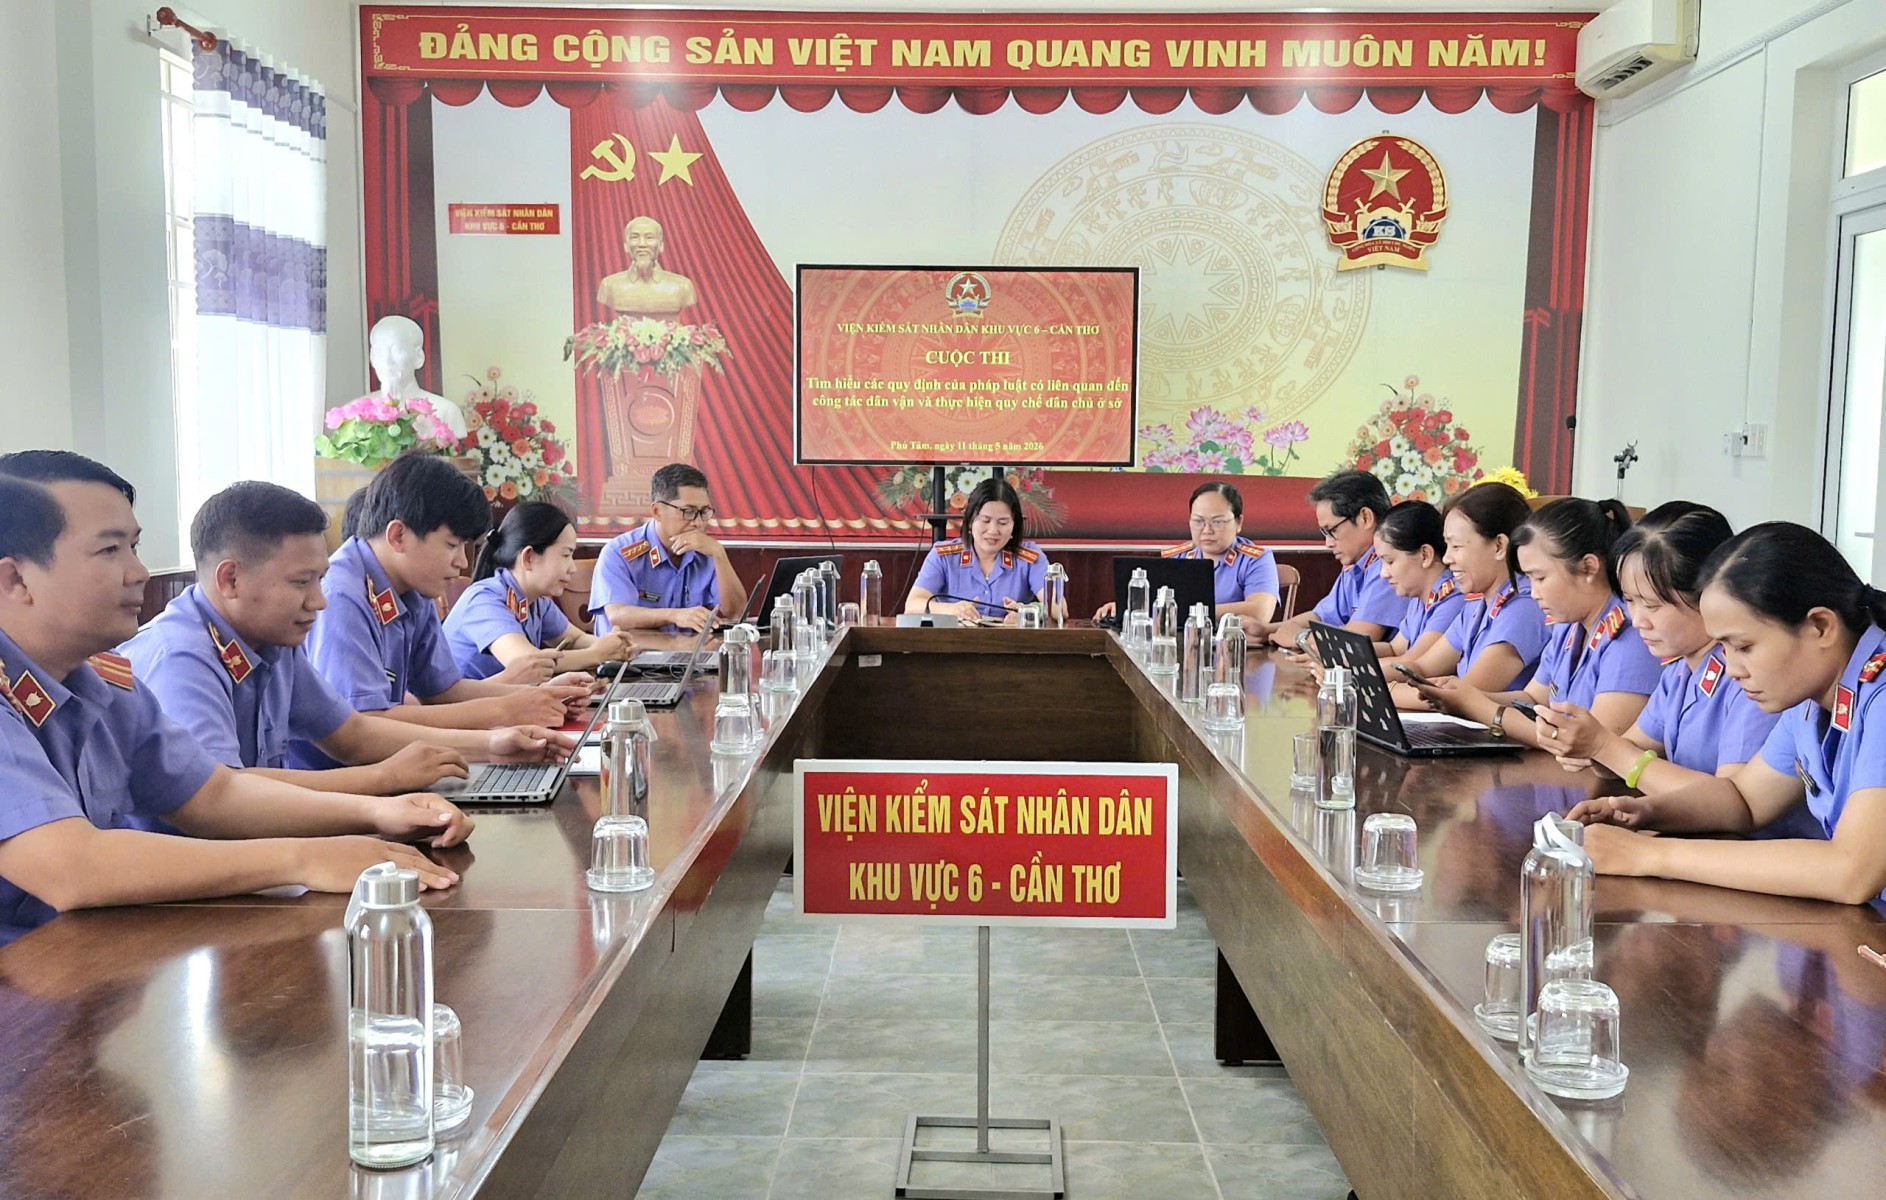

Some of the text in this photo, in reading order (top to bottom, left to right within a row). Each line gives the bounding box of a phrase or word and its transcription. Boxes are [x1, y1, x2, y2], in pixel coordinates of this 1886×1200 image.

[420, 23, 1546, 72] ĐẢNG CỘNG SẢN VIỆT NAM QUANG VINH MUÔN NĂM!
[838, 323, 863, 335] VIỆN
[867, 322, 896, 333] KIỂM
[899, 322, 919, 333] SÁT
[922, 322, 953, 334] NHÂN
[956, 323, 978, 334] DÂN
[981, 325, 1006, 334] KHU
[1008, 325, 1032, 336] VỰC
[1034, 325, 1040, 334] 6
[1050, 324, 1073, 335] CẦN
[1075, 325, 1100, 335] THƠ
[926, 350, 1011, 367] CUỘC THI
[806, 375, 1129, 393] Tìm hiểu các quy định của pháp luật có liên quan đến
[818, 779, 1153, 841] VIỆN KIỂM SÁT NHÂN DÂN
[849, 851, 1122, 910] KHU VỰC 6 - CẦN THƠ
